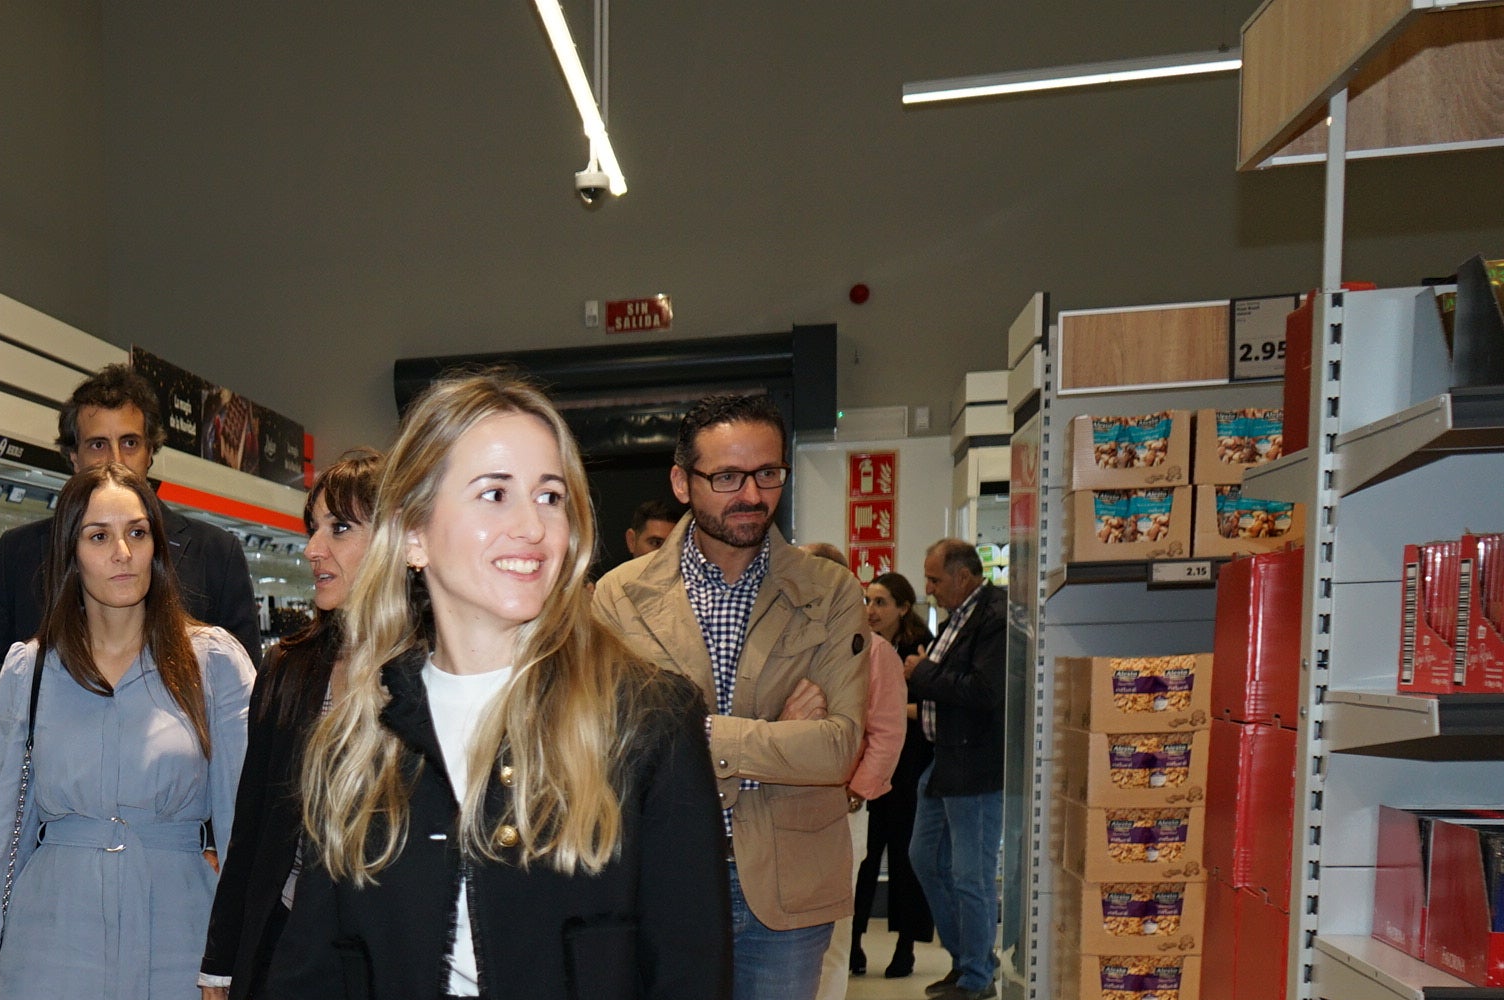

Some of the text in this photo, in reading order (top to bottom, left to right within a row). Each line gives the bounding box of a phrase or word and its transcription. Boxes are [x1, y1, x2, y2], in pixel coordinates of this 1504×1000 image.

[626, 302, 649, 316] SIN
[615, 314, 661, 330] SALIDA
[1239, 341, 1287, 362] 2.95
[1186, 567, 1207, 576] 2.15
